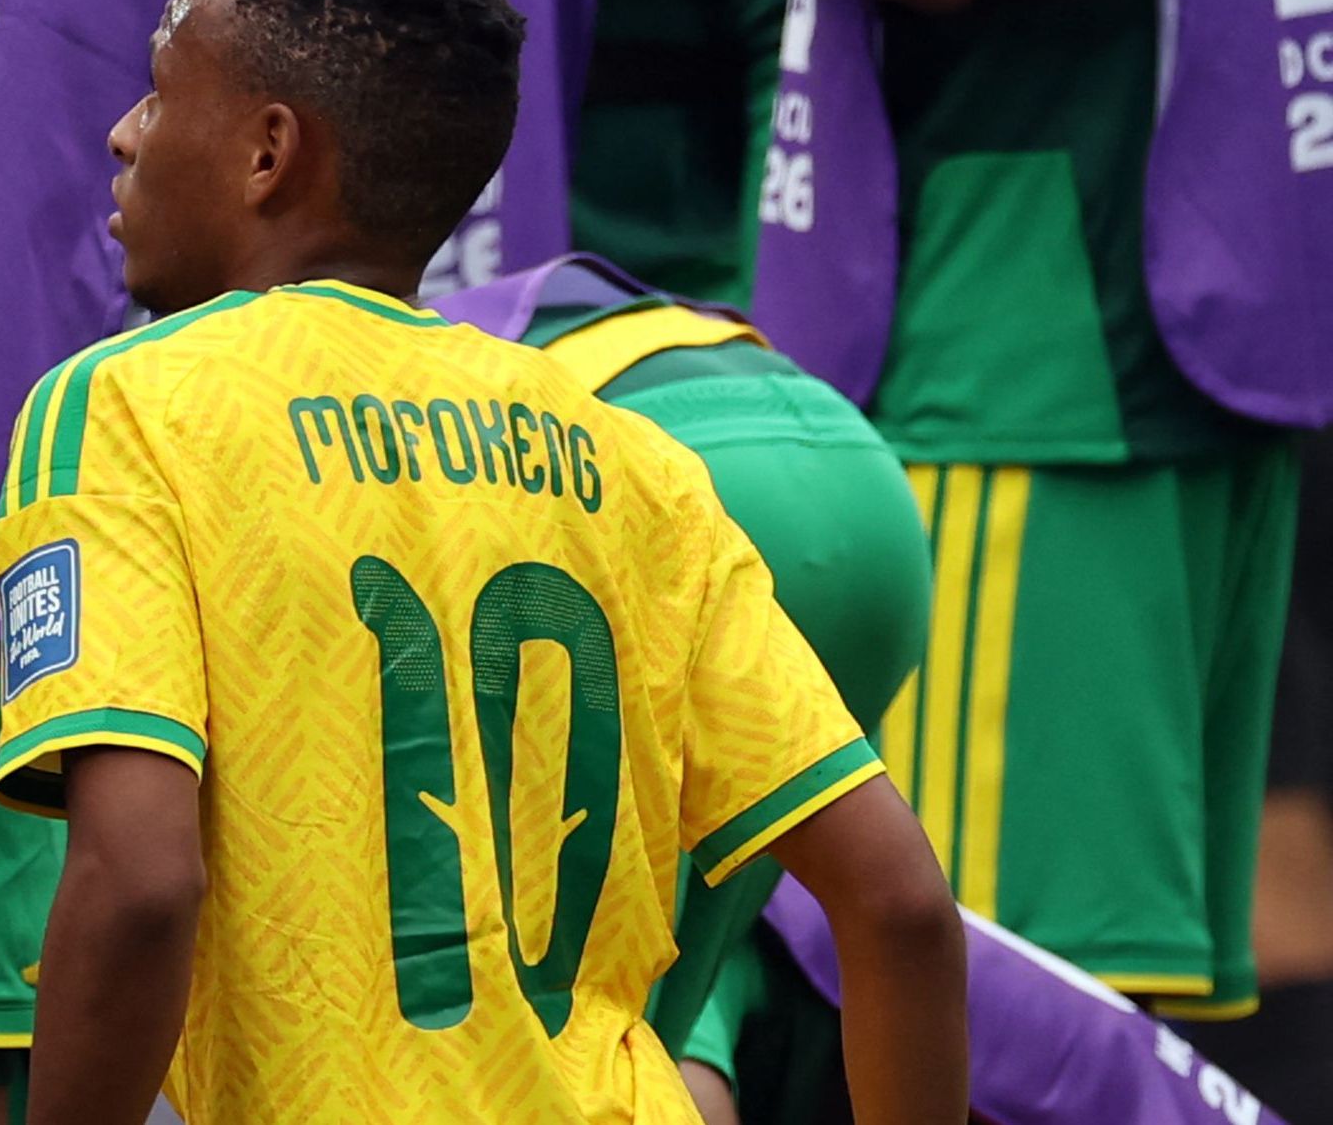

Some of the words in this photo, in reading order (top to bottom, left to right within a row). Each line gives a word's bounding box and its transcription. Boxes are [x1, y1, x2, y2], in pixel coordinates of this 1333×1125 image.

[758, 143, 815, 233] 26
[288, 394, 603, 513] MOFOKENG
[9, 565, 60, 610] FOOTBALL
[9, 585, 61, 637] UNITES
[21, 611, 66, 651] World
[350, 555, 622, 1039] 10
